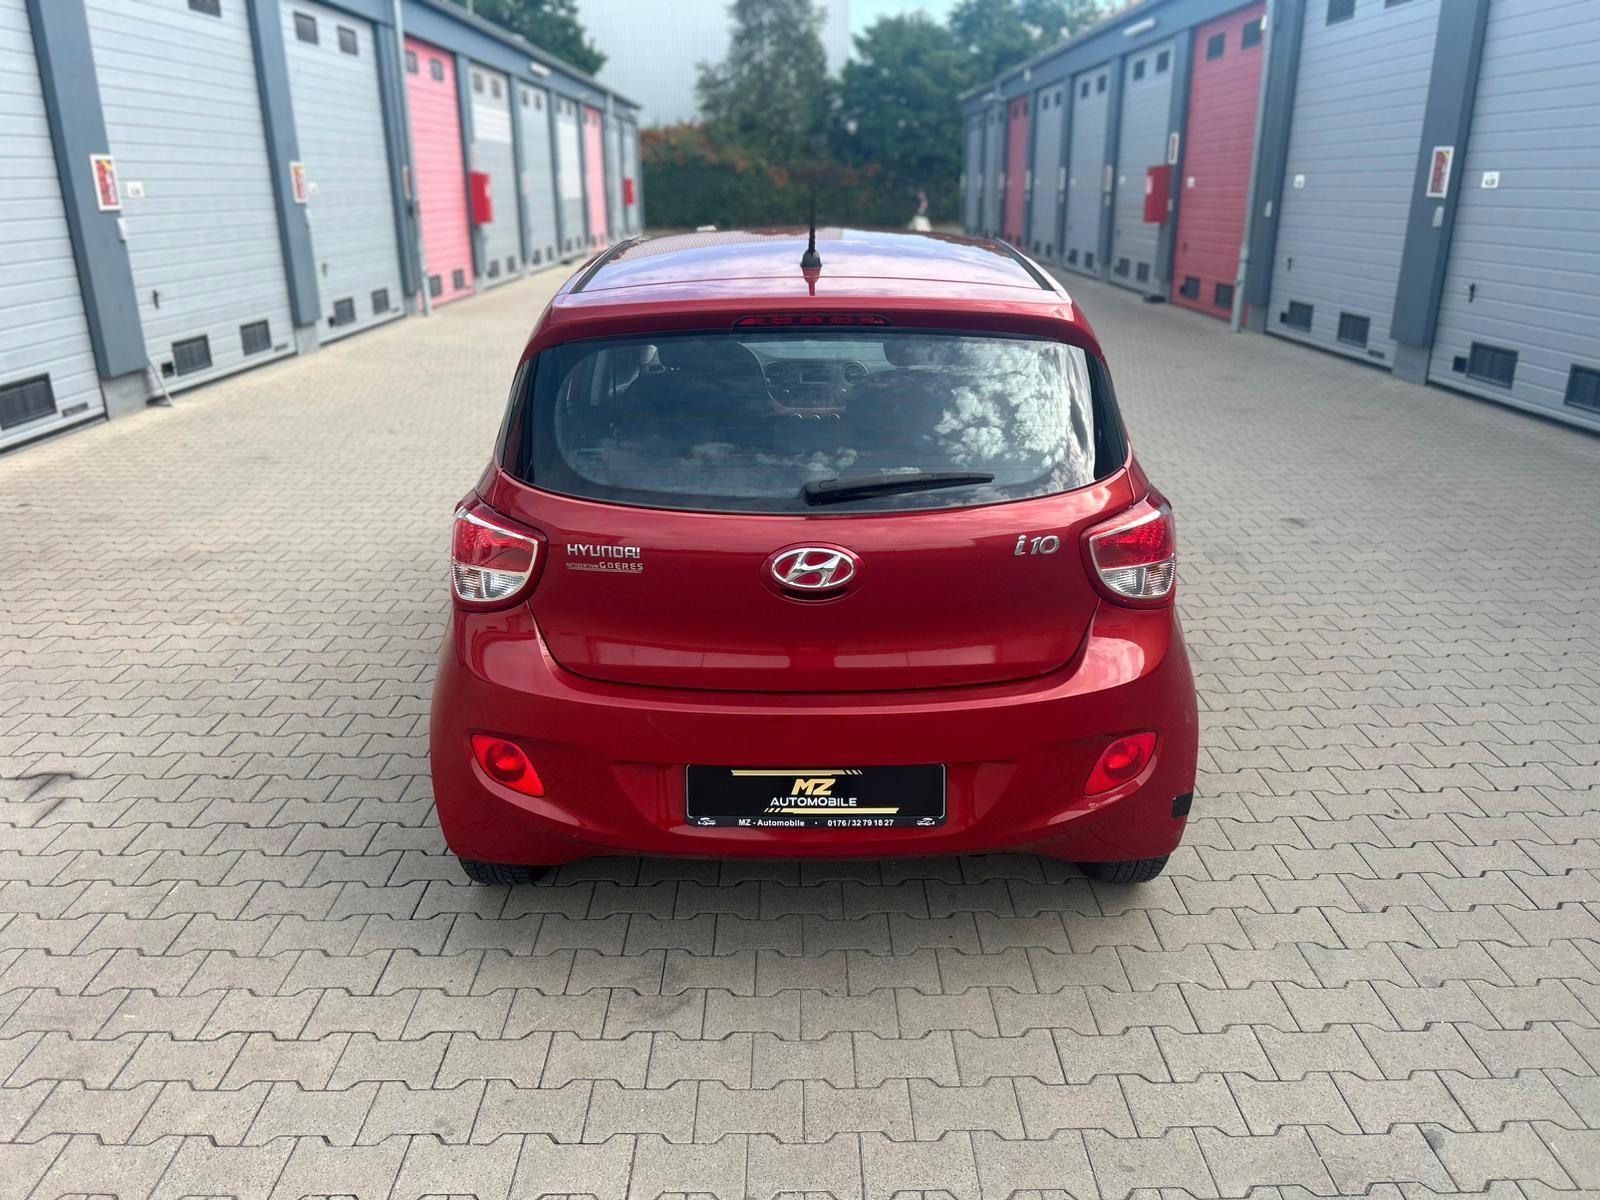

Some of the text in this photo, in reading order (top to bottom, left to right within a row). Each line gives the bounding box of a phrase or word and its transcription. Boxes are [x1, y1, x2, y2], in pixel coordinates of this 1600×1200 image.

[567, 543, 641, 559] HYUNDAI
[1014, 534, 1060, 556] i10
[790, 778, 836, 795] MZ
[769, 797, 858, 806] AUTOMOBILE
[757, 819, 805, 827] Automobile
